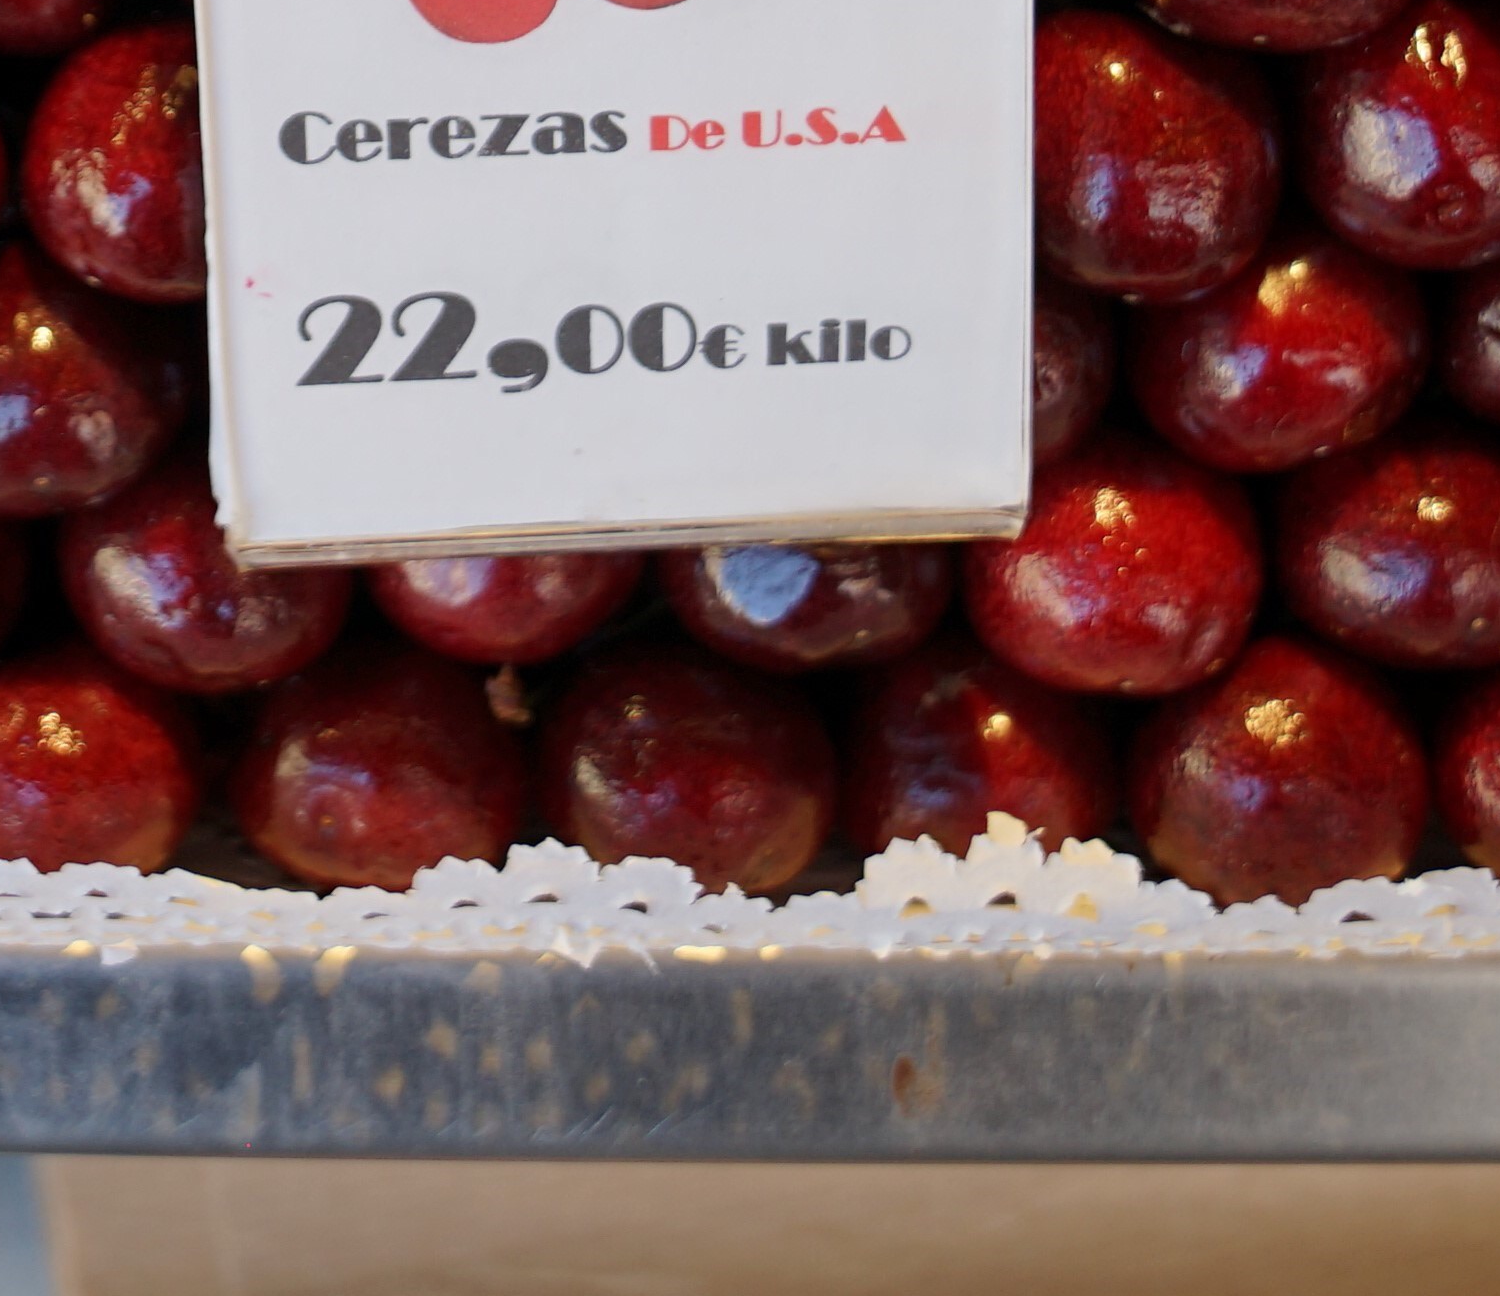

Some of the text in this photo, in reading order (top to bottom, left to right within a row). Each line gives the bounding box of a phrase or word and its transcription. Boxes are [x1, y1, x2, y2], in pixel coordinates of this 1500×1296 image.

[278, 105, 907, 166] Cerezas De U.S.A
[296, 291, 913, 394] 22,00€ kilo
